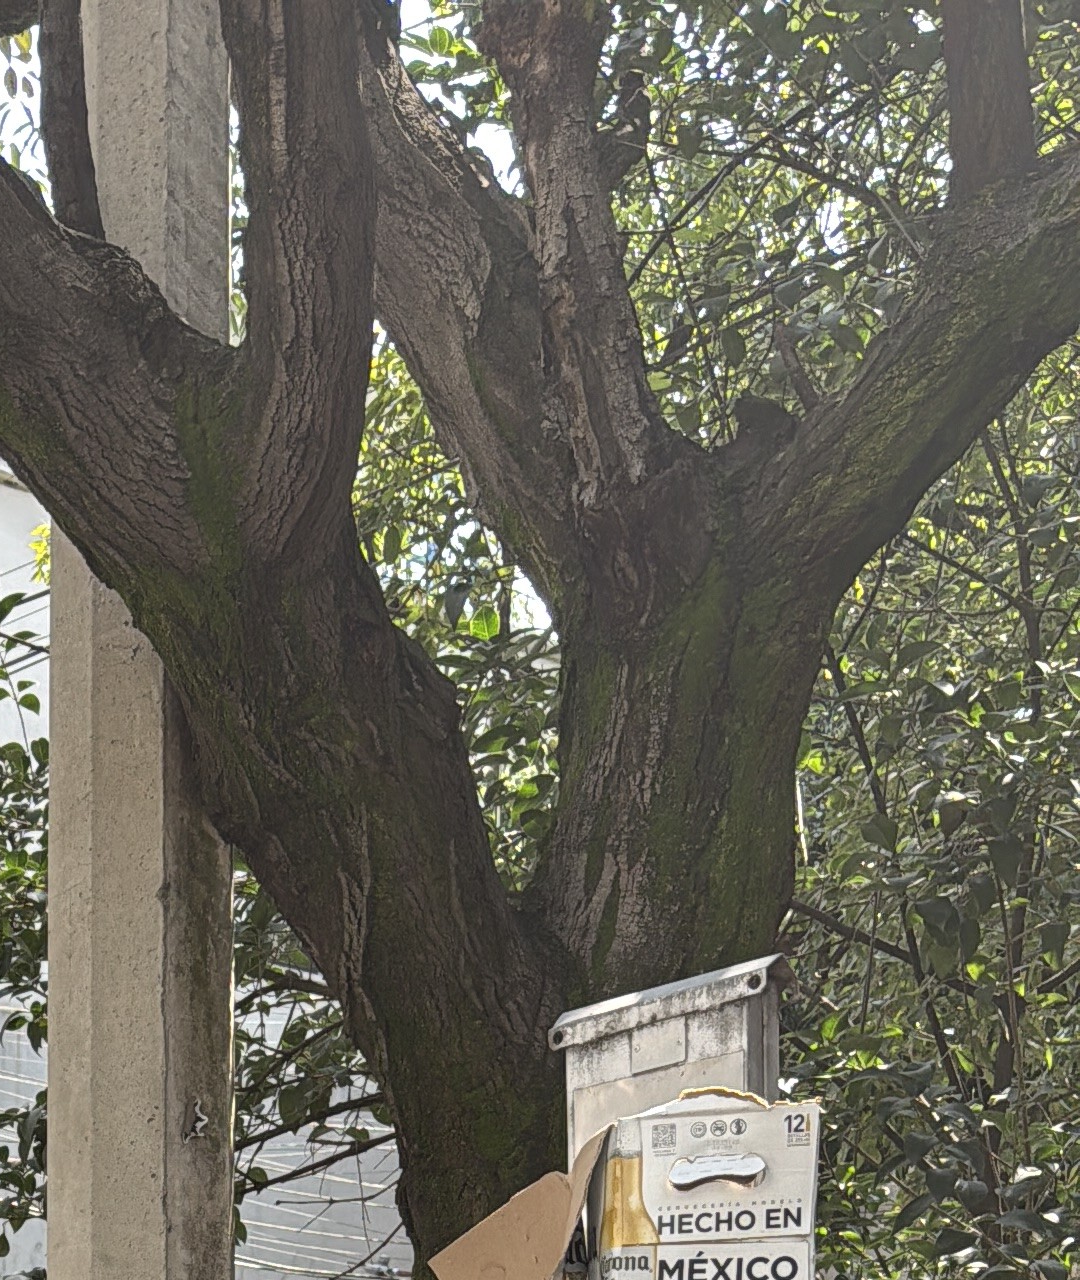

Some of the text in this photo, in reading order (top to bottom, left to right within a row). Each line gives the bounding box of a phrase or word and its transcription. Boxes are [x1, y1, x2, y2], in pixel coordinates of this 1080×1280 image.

[784, 1113, 805, 1133] 12
[658, 1207, 802, 1235] HECHO EN
